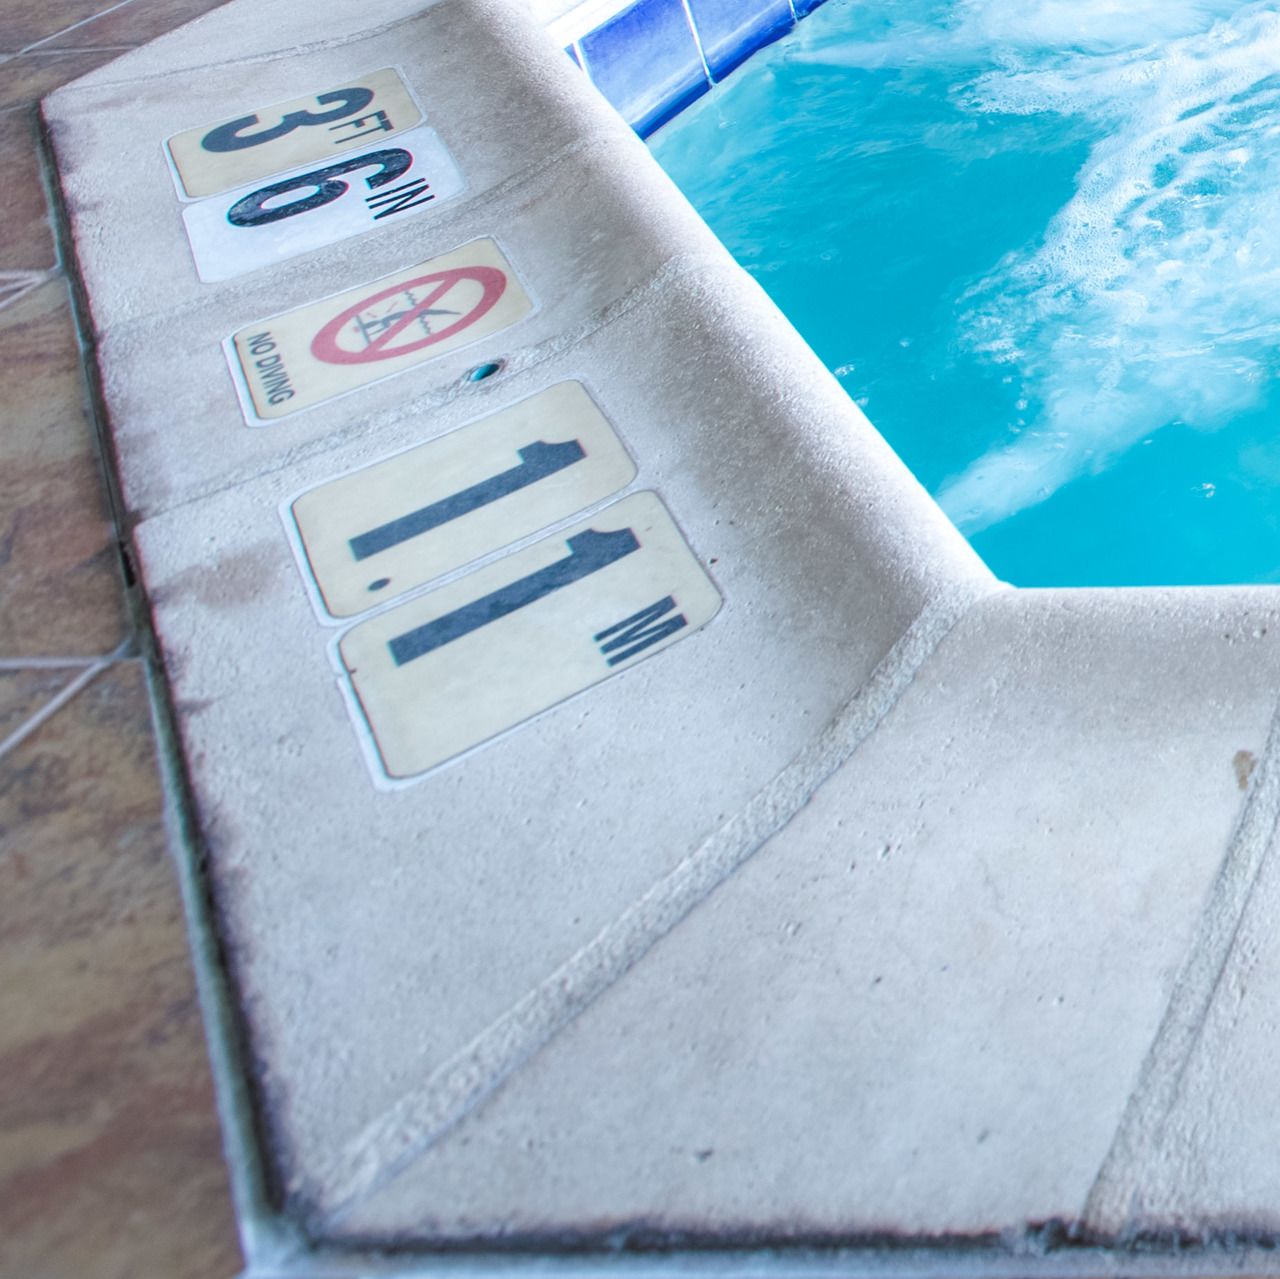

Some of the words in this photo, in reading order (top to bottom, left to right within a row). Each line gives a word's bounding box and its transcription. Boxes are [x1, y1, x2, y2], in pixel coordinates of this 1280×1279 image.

[201, 87, 375, 153] 3
[328, 109, 395, 145] FT
[226, 147, 415, 228] 6
[365, 177, 436, 220] IN
[246, 331, 277, 356] NO
[255, 353, 296, 406] DIVING
[594, 595, 689, 668] M
